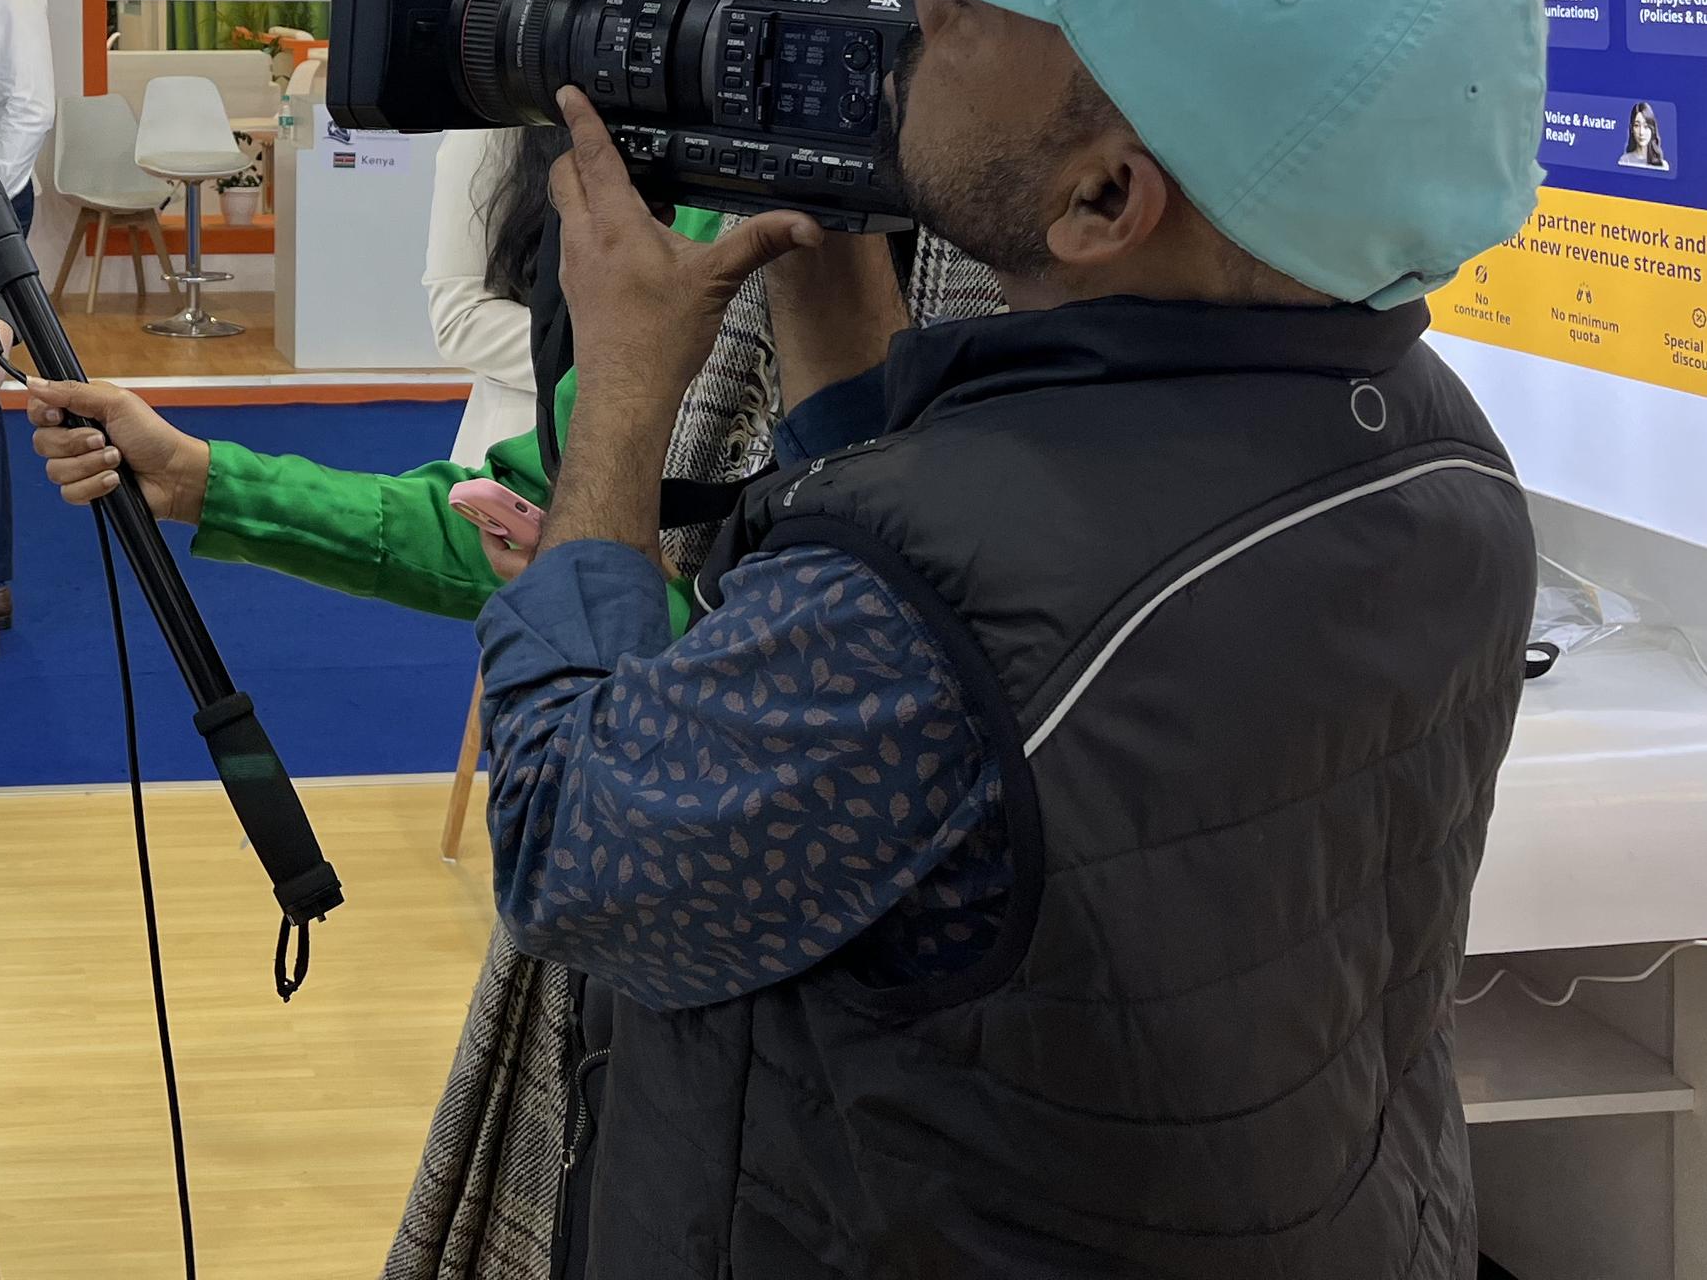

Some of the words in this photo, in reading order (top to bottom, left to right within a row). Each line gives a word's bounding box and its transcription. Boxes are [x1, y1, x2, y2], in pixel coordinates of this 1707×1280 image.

[1544, 6, 1599, 21] unications)
[1639, 9, 1683, 25] (Policies
[1685, 11, 1694, 24] &
[634, 31, 653, 40] FOCUS
[1544, 110, 1572, 125] Voice
[1572, 113, 1581, 126] &
[1582, 114, 1617, 131] Avatar
[1545, 128, 1575, 146] Ready
[361, 155, 395, 167] Kenya
[1537, 211, 1596, 235] partner
[1601, 223, 1670, 249] network
[1675, 235, 1707, 255] and
[1530, 238, 1561, 256] new
[1566, 243, 1629, 269] revenue
[1634, 255, 1702, 283] streams
[1475, 292, 1489, 305] No
[1454, 303, 1494, 322] contract
[1495, 310, 1511, 325] fee
[1550, 307, 1566, 321] No
[1568, 312, 1619, 333] minimum
[1569, 328, 1600, 344] quota
[1664, 333, 1704, 354] Special
[1672, 351, 1707, 371] discou
